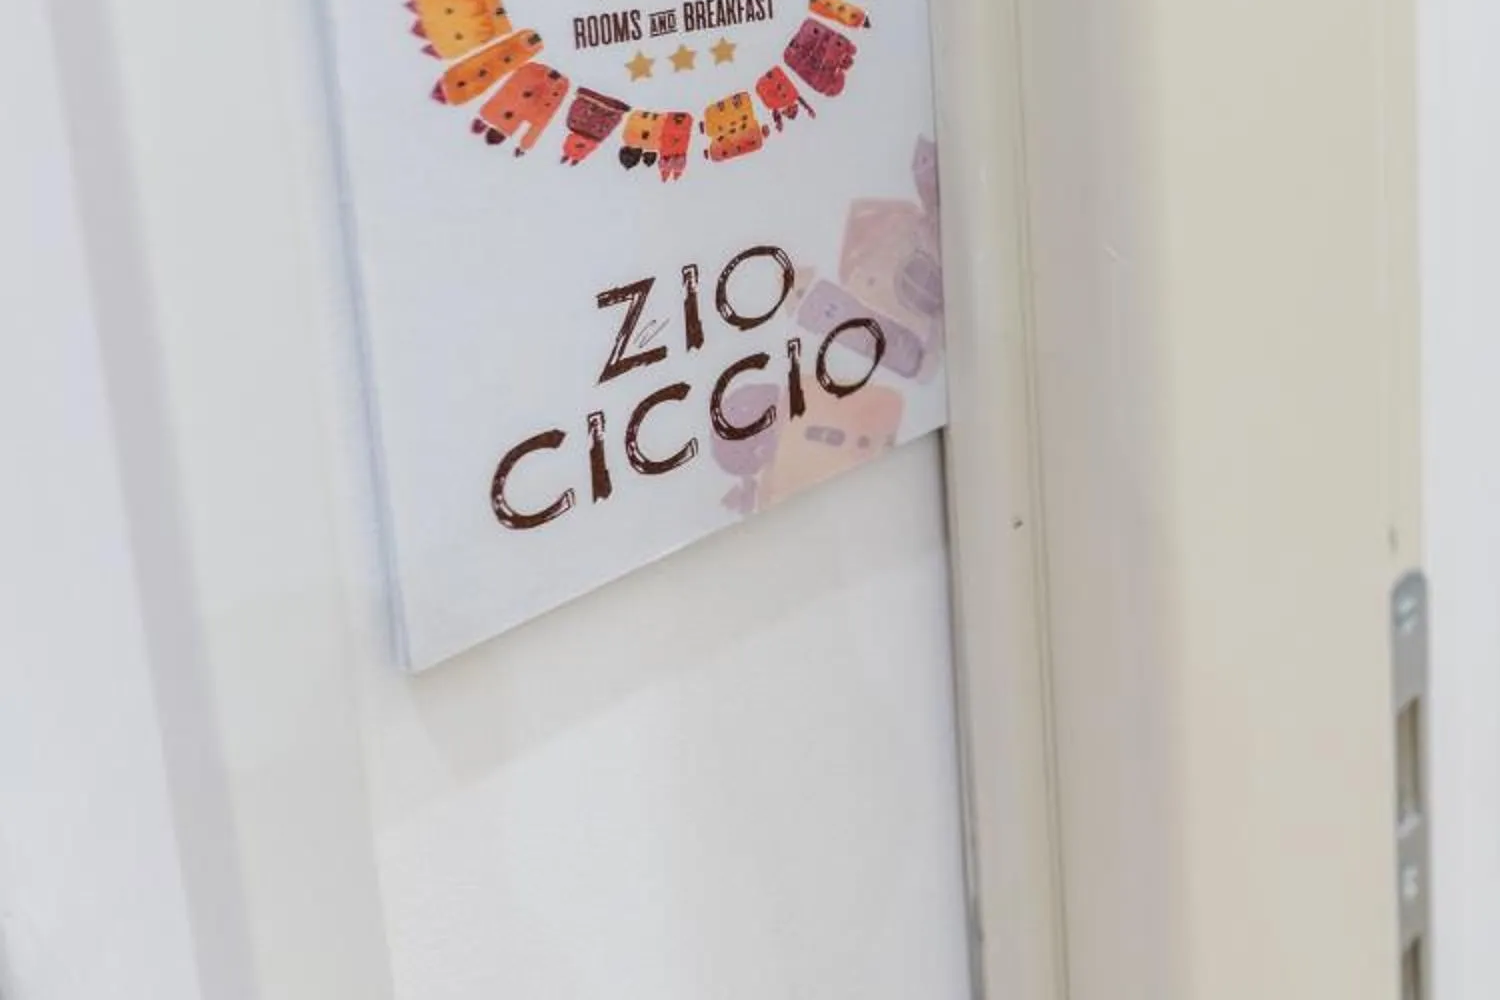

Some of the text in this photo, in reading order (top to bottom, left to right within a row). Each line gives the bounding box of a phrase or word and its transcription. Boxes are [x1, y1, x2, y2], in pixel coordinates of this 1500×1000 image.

[573, 9, 642, 50] ROOMS
[649, 10, 677, 35] AND
[596, 245, 795, 384] ZIO
[491, 317, 886, 530] CICCIO
